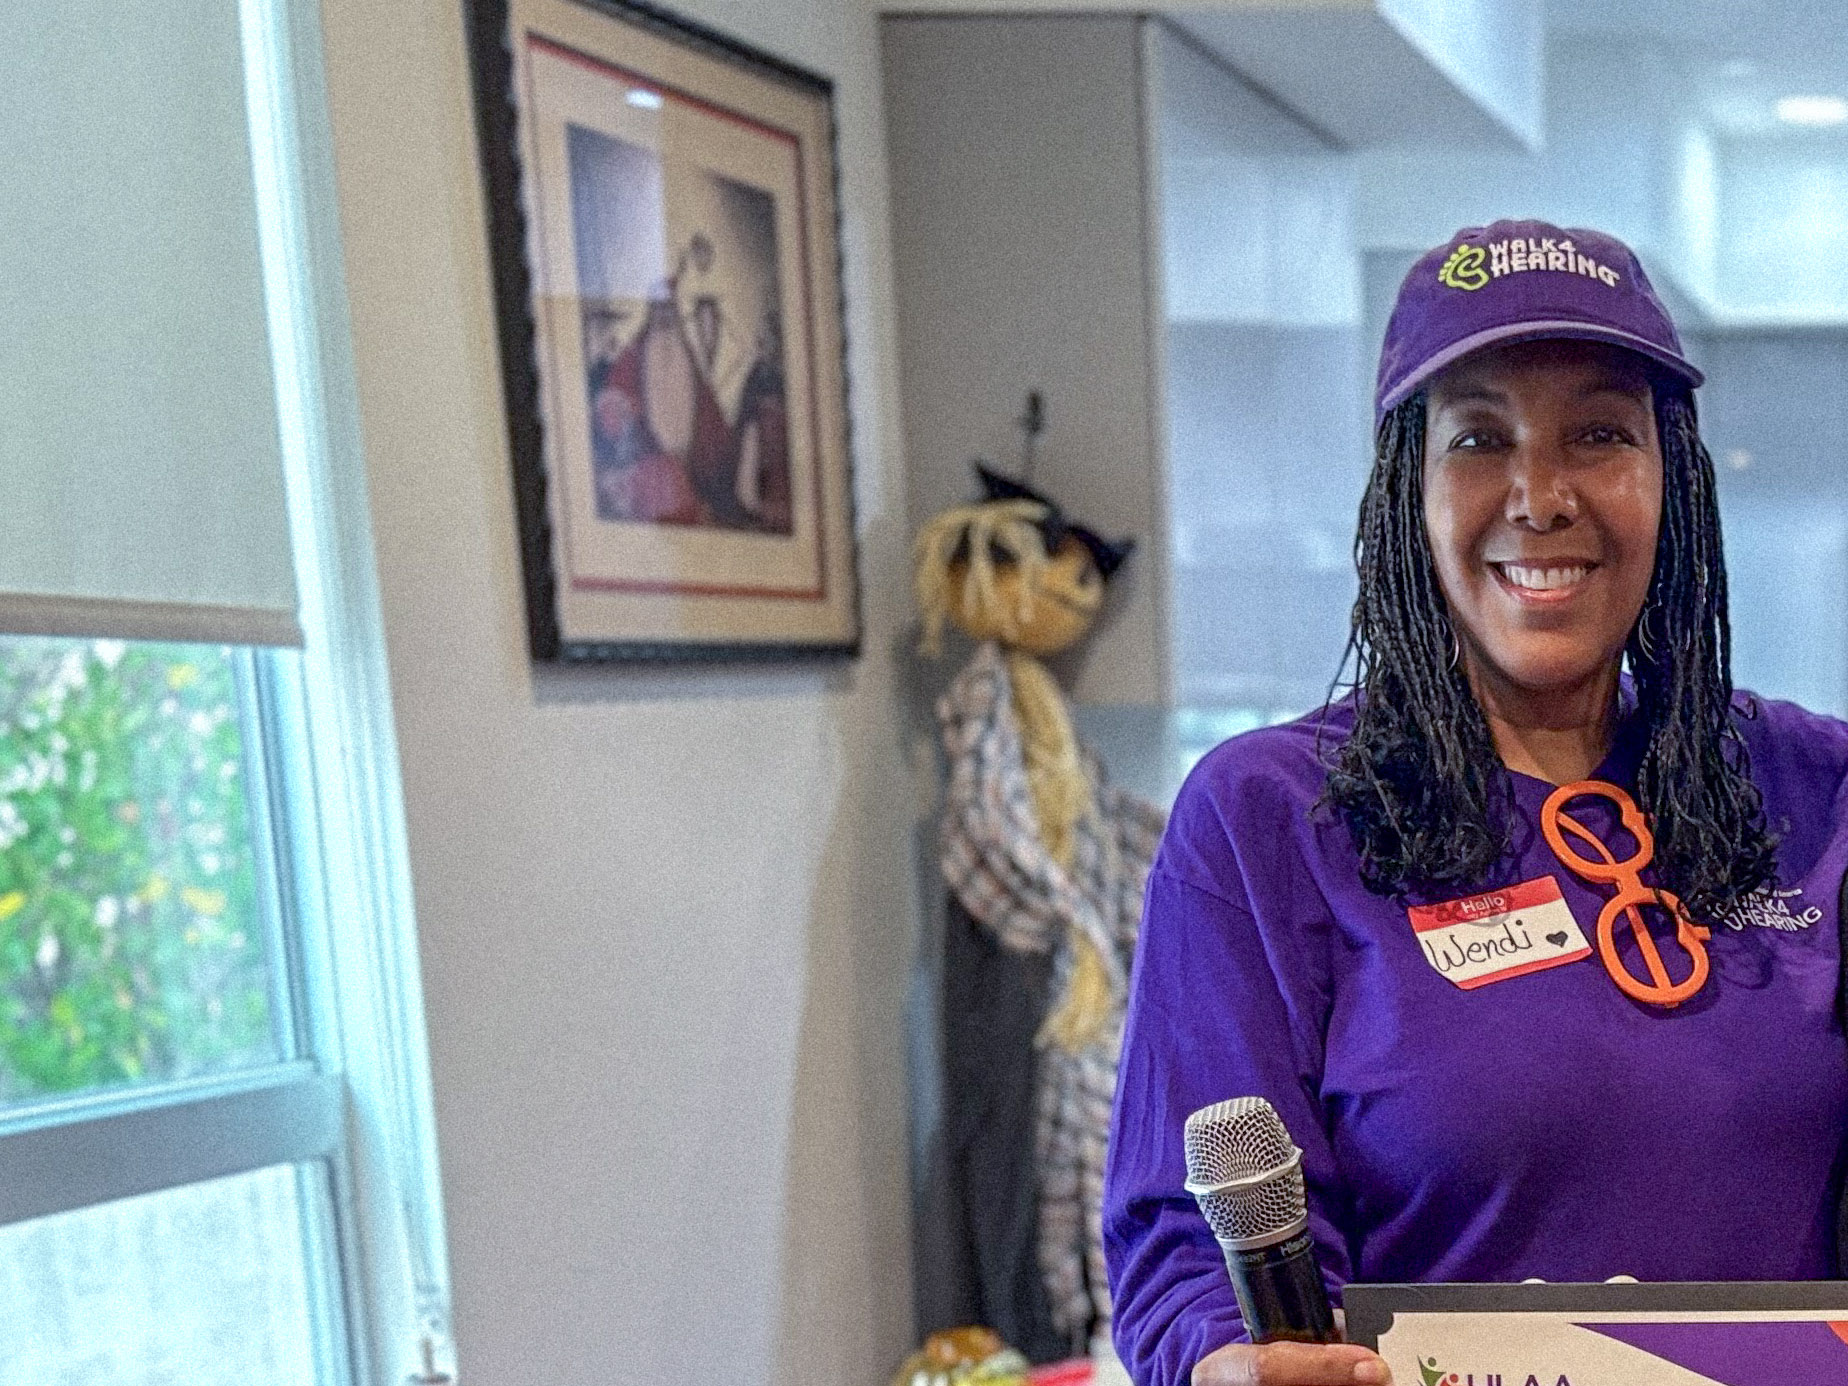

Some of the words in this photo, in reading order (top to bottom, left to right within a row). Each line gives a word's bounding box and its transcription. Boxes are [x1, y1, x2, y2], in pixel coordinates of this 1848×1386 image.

[1489, 238, 1576, 259] WALK4
[1491, 251, 1620, 288] HEARING
[1460, 896, 1505, 914] Hello
[1738, 906, 1822, 932] HEARING
[1425, 919, 1533, 972] Wendi
